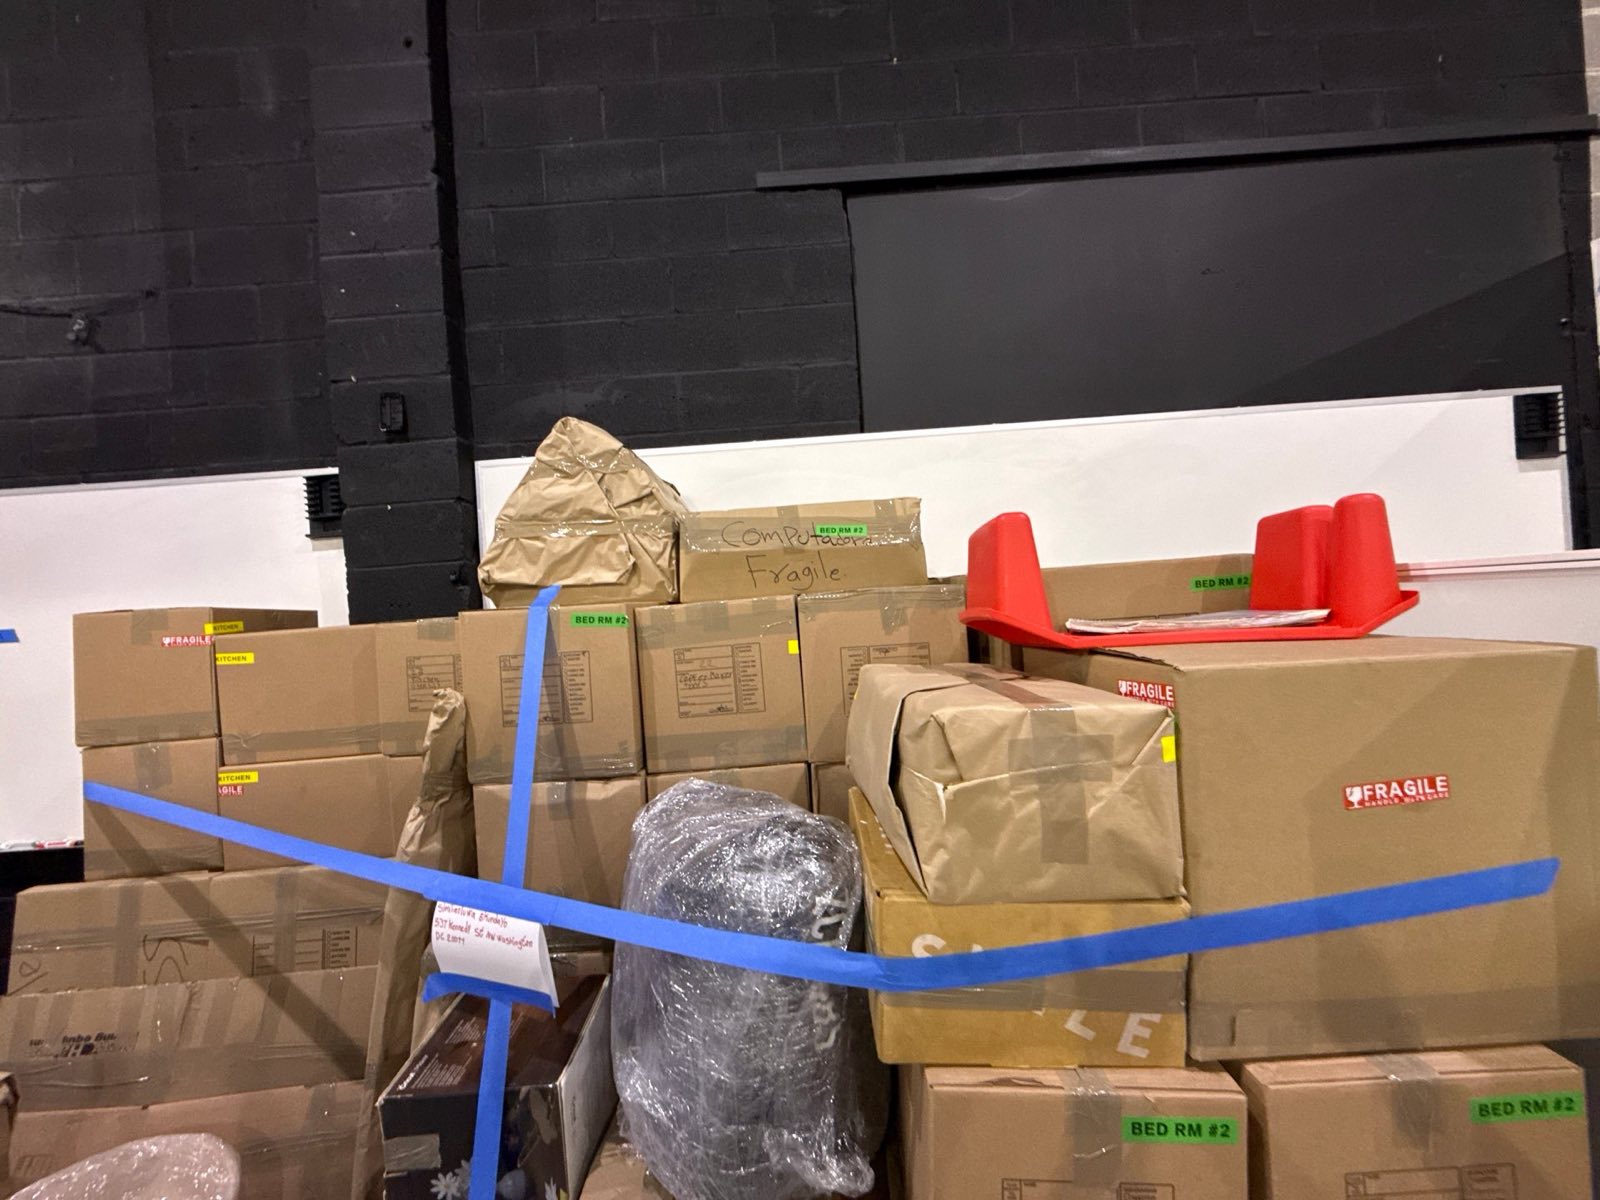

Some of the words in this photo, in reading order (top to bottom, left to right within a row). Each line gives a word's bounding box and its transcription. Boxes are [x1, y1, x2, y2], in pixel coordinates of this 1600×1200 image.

[819, 526, 837, 534] BED
[1194, 579, 1216, 589] BED
[1218, 577, 1234, 587] RM
[575, 615, 595, 625] BED
[597, 615, 613, 625] RM
[615, 615, 628, 625] #2
[213, 623, 239, 632] KITCHEN
[169, 635, 212, 645] FRAGILE
[1126, 681, 1174, 701] FRAGILE
[1363, 775, 1449, 801] FRAGILE
[1478, 1101, 1515, 1118] BED
[1520, 1099, 1549, 1115] RM
[1553, 1096, 1575, 1112] #2
[1130, 1121, 1168, 1137] BED
[1174, 1122, 1203, 1138] RM
[1208, 1123, 1231, 1139] #2
